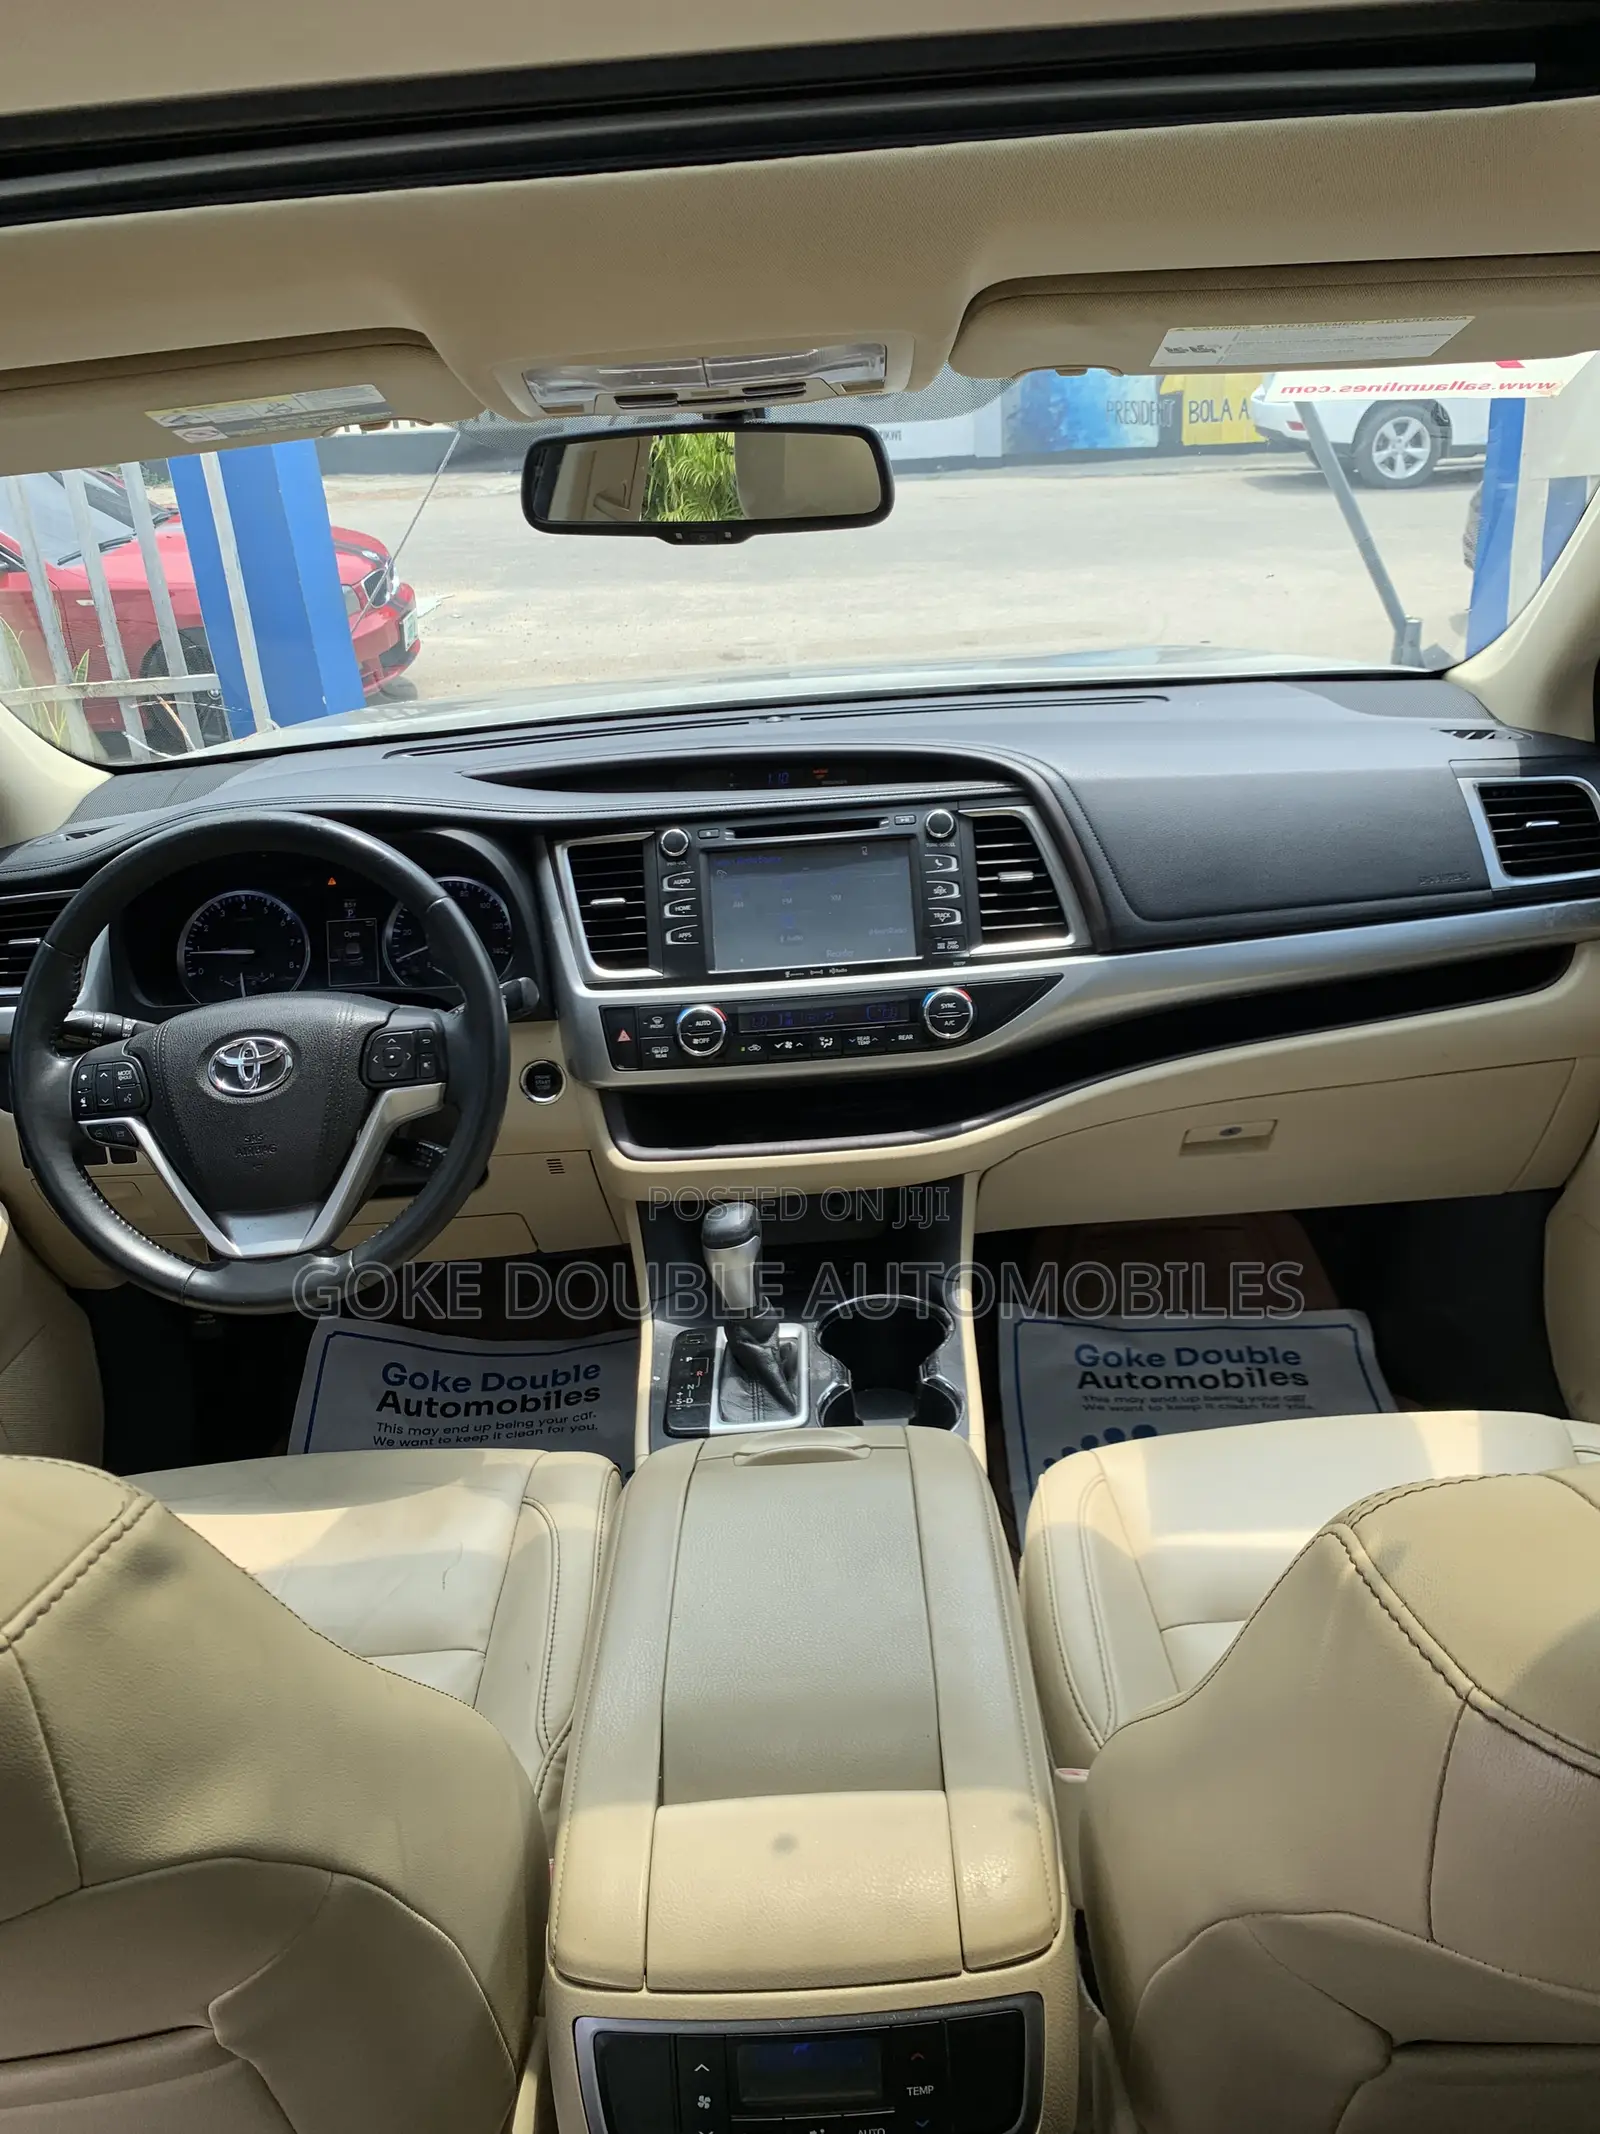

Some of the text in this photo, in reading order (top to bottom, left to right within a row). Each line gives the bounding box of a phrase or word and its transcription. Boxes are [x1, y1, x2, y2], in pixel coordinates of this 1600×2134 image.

[1188, 399, 1232, 424] BOLA
[198, 967, 204, 975] 0
[1074, 1344, 1301, 1368] Goke Double
[382, 1362, 601, 1393] Goke Double
[1077, 1368, 1309, 1389] Automobiles
[376, 1386, 602, 1418] Automobiles
[1114, 1396, 1146, 1405] may
[1149, 1395, 1178, 1403] end
[1181, 1396, 1201, 1404] up
[1148, 1404, 1164, 1412] to
[373, 1423, 598, 1447] We want to keep it clean for you.
[377, 1411, 598, 1437] This may end up being your car.
[906, 2085, 935, 2097] TEMP
